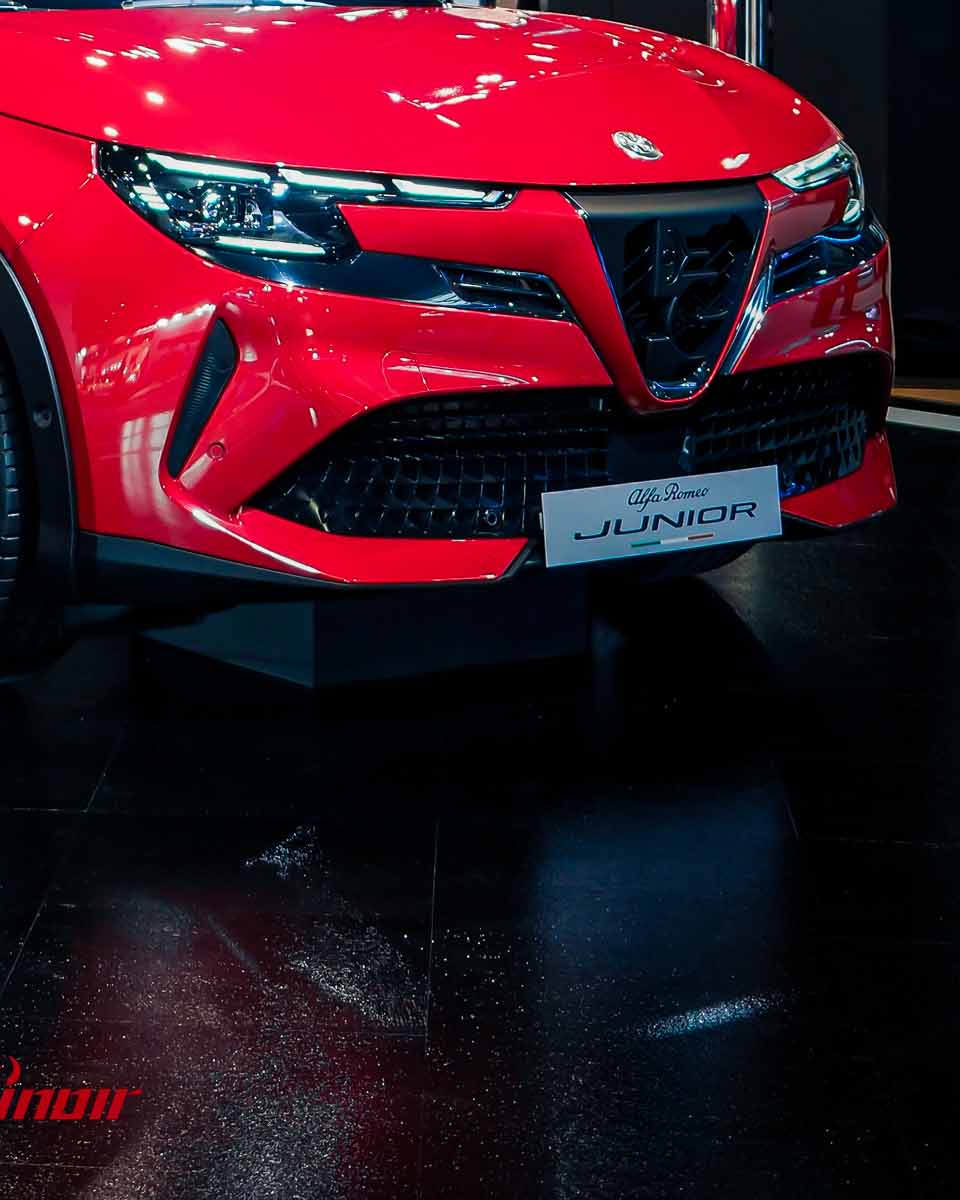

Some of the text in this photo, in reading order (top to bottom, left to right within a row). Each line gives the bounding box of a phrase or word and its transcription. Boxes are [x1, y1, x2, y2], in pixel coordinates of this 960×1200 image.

[627, 482, 710, 512] Alfa Romeo
[573, 502, 758, 540] JUNIOR
